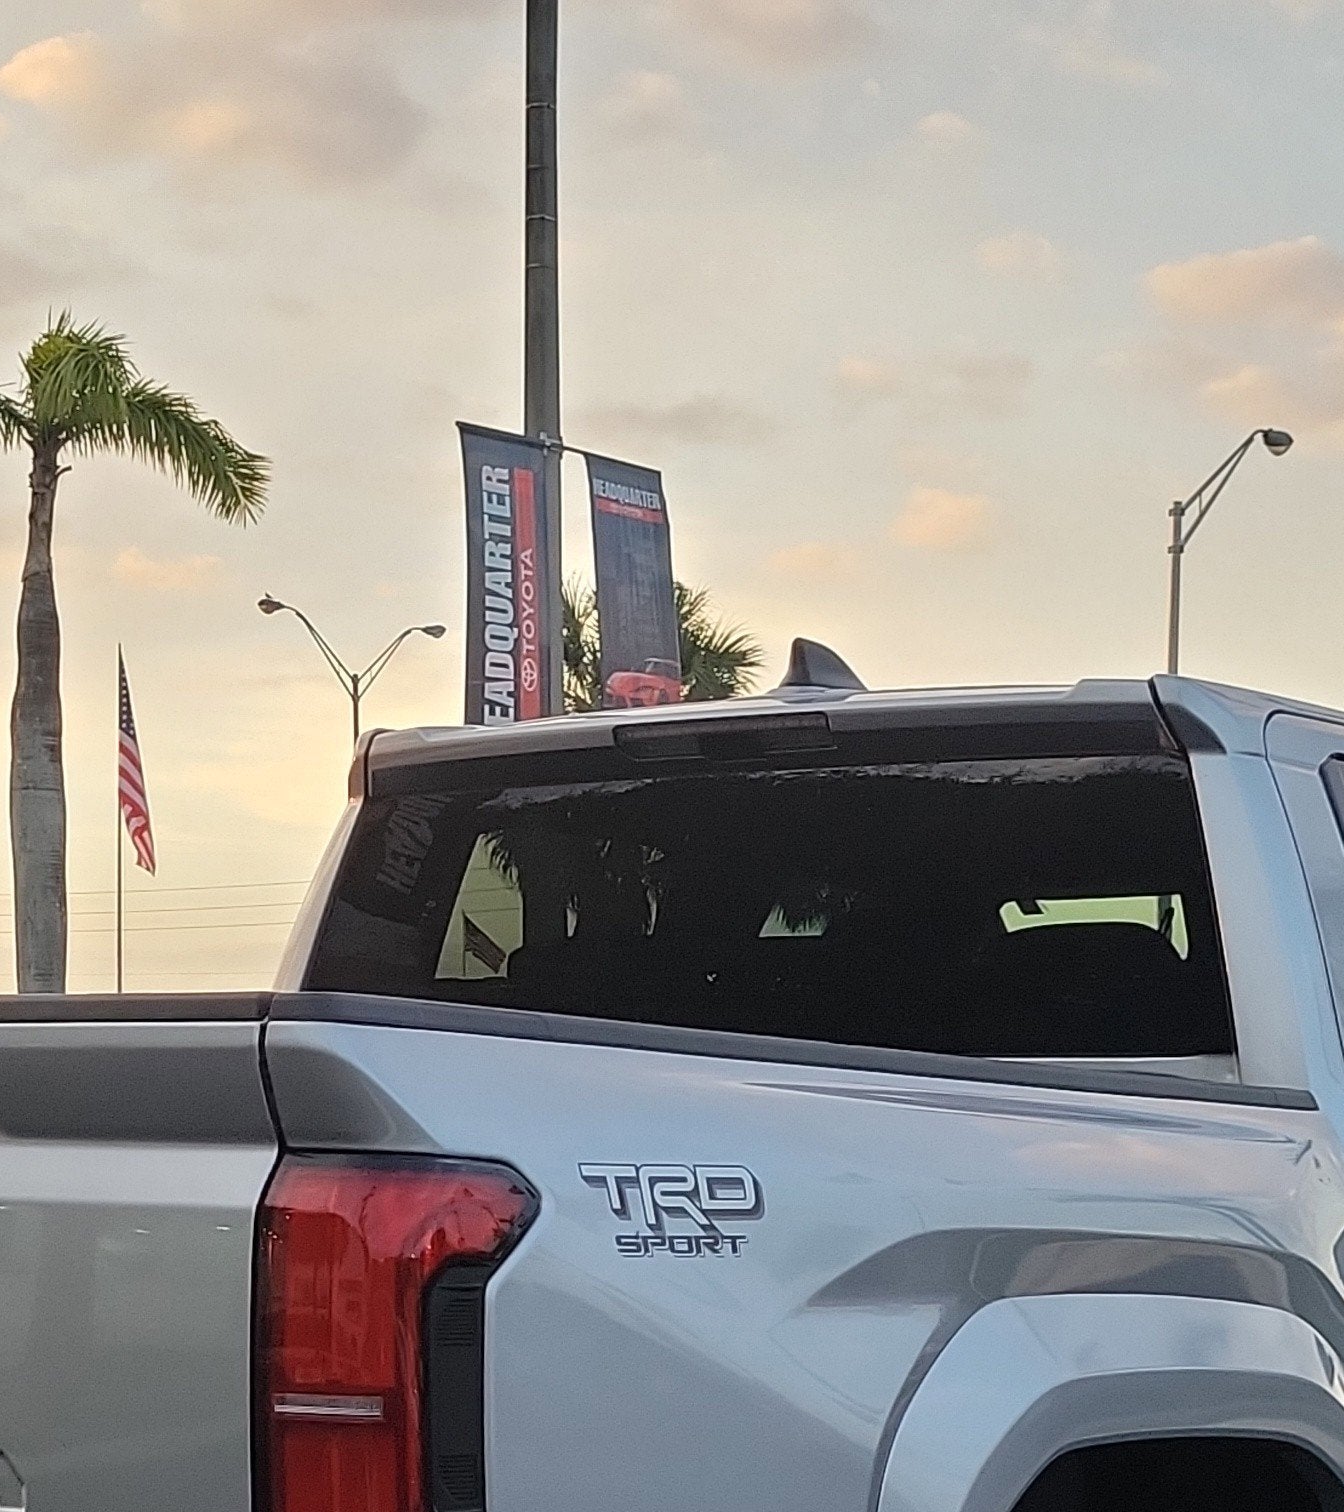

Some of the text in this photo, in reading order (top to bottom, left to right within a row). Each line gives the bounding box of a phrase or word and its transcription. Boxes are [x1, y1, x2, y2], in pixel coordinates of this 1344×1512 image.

[482, 465, 518, 727] EADQUARTER
[521, 548, 534, 654] TOYOTA
[578, 1162, 763, 1232] TRD
[614, 1234, 749, 1258] SPORT
